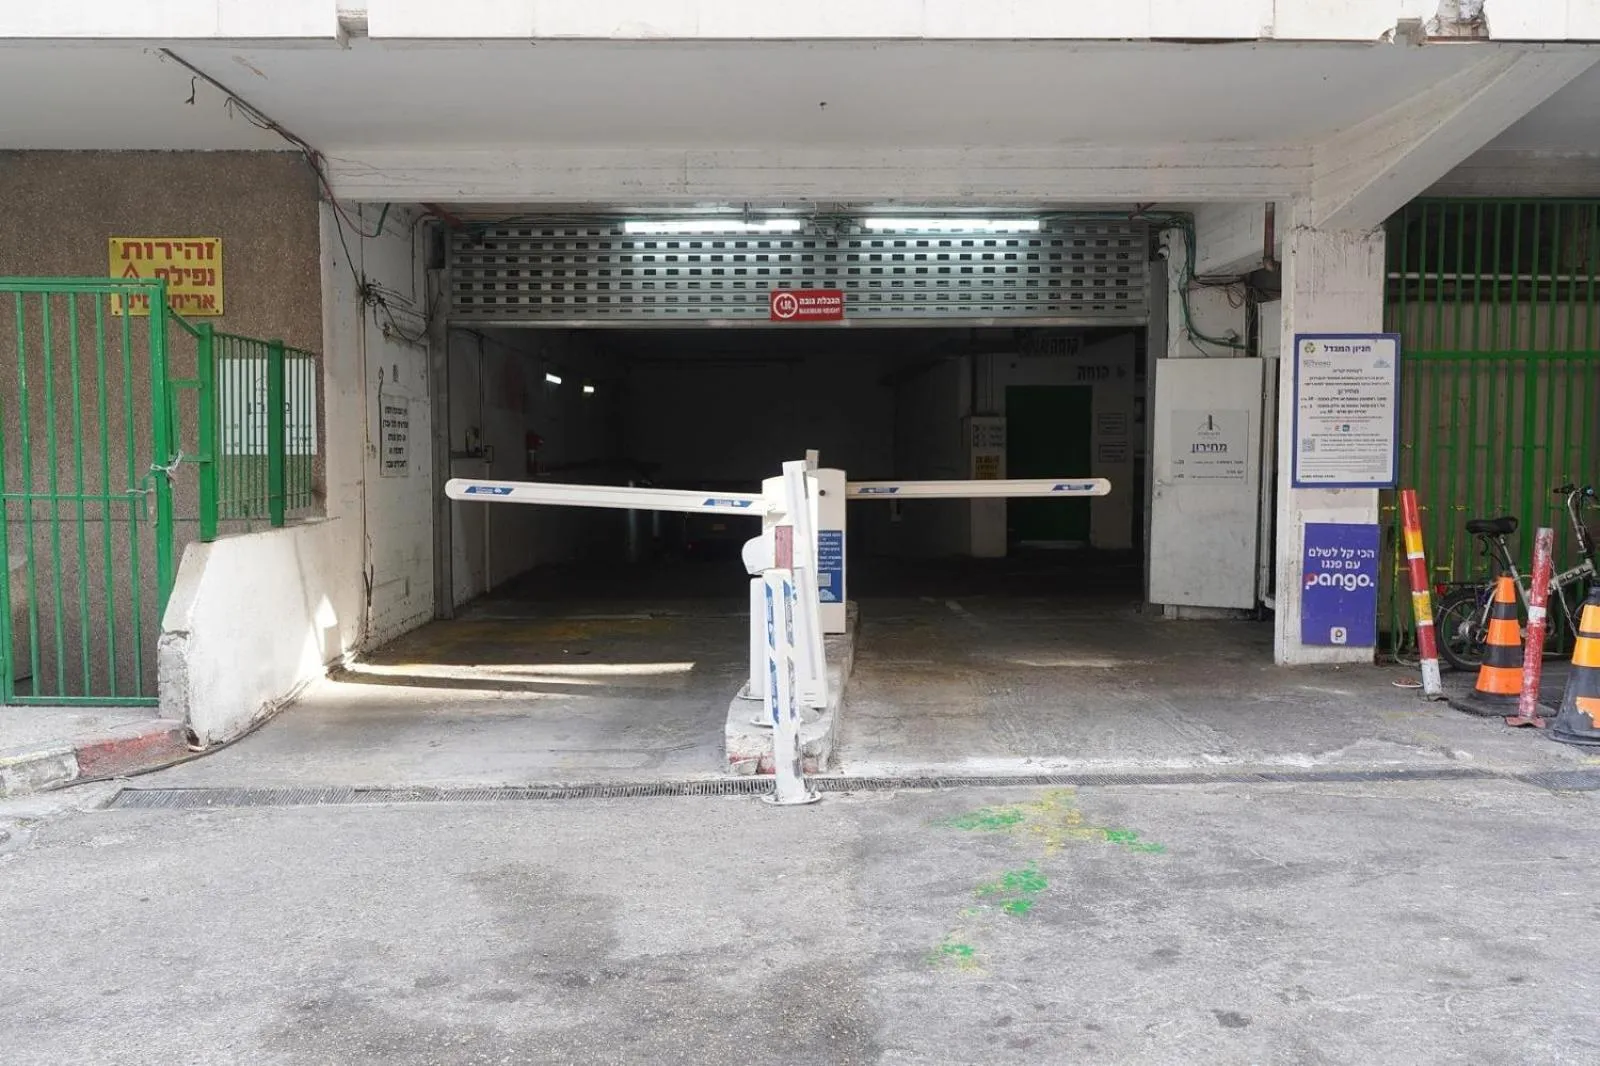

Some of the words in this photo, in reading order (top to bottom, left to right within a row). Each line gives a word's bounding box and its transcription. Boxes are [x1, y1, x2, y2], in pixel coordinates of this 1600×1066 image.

[121, 242, 215, 260] זהירות
[1353, 345, 1371, 354] חניון
[1191, 443, 1228, 454] מחירון
[1308, 546, 1338, 557] לשלם
[1340, 547, 1354, 559] קל
[1357, 549, 1374, 558] הכי
[1321, 560, 1342, 569] פנגו
[1345, 561, 1360, 569] עם
